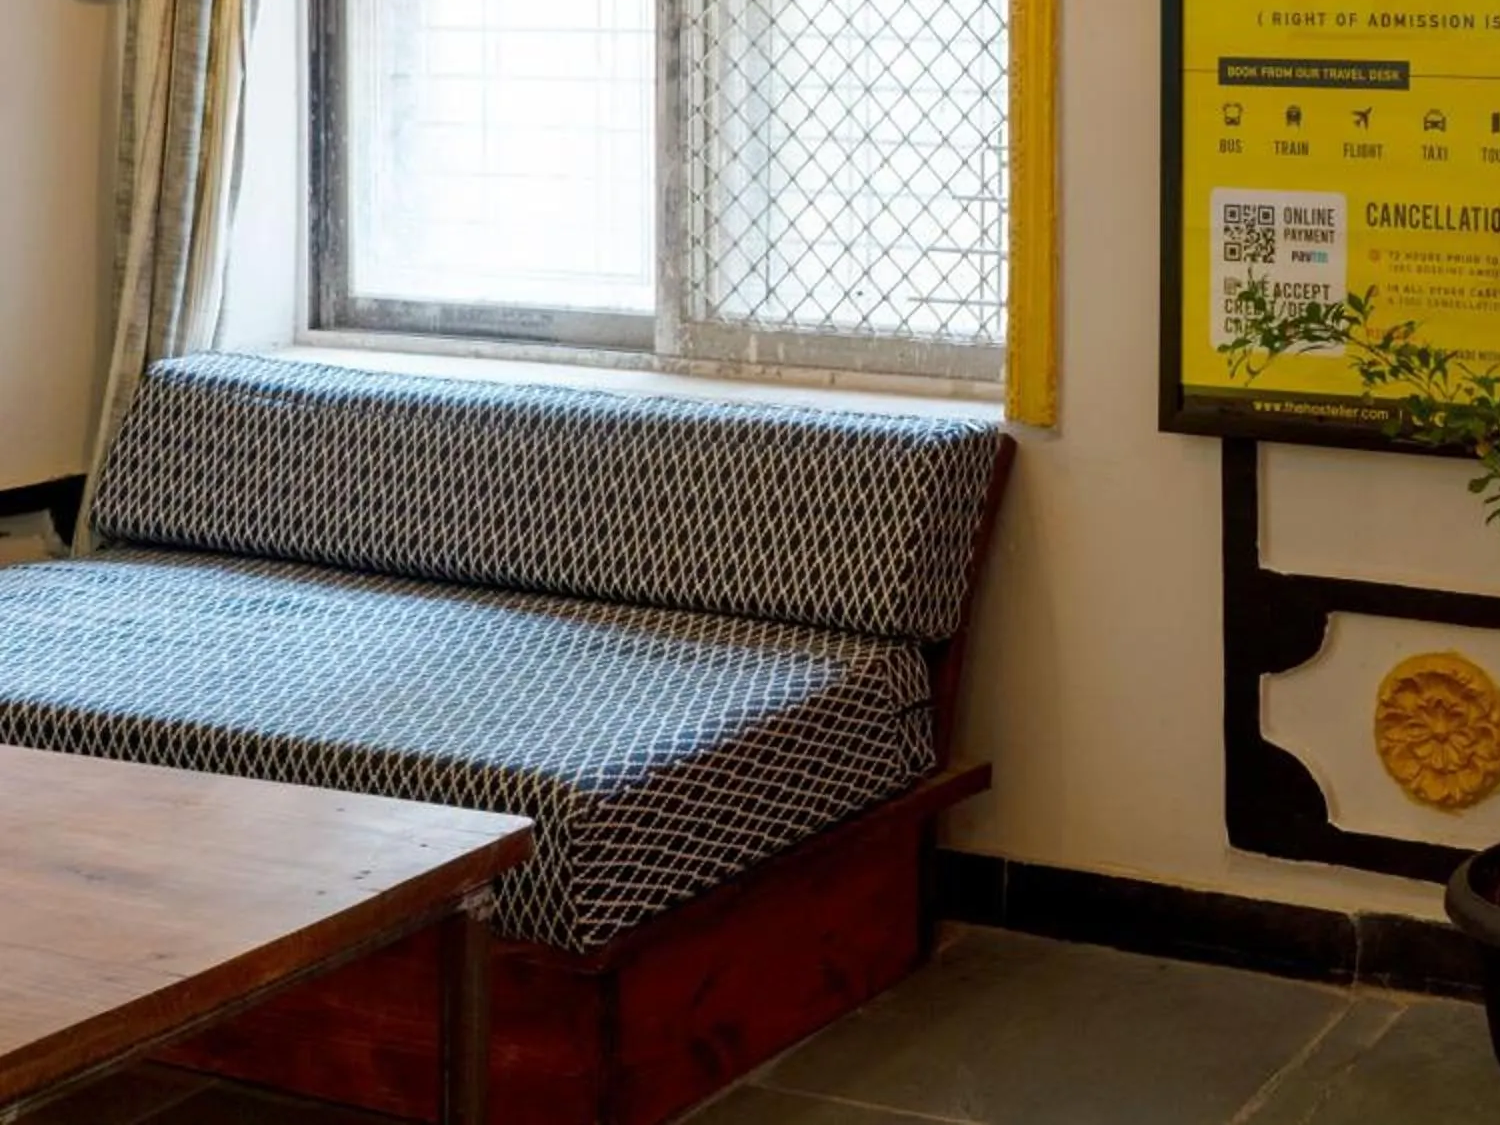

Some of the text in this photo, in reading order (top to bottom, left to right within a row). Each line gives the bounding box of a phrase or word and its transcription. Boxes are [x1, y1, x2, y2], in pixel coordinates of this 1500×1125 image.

[1272, 12, 1326, 27] RIGHT
[1335, 12, 1358, 27] OF
[1368, 12, 1475, 29] ADMISSION
[1227, 65, 1401, 81] BOOK FROM OUR TRAVEL DESK
[1219, 138, 1243, 154] BUS
[1274, 140, 1309, 156] TRAIN
[1343, 142, 1383, 159] FLIGHT
[1422, 144, 1448, 161] TAXI
[1283, 207, 1335, 227] ONLINE
[1284, 227, 1335, 244] PAYMENT
[1274, 282, 1331, 300] ACCEPT
